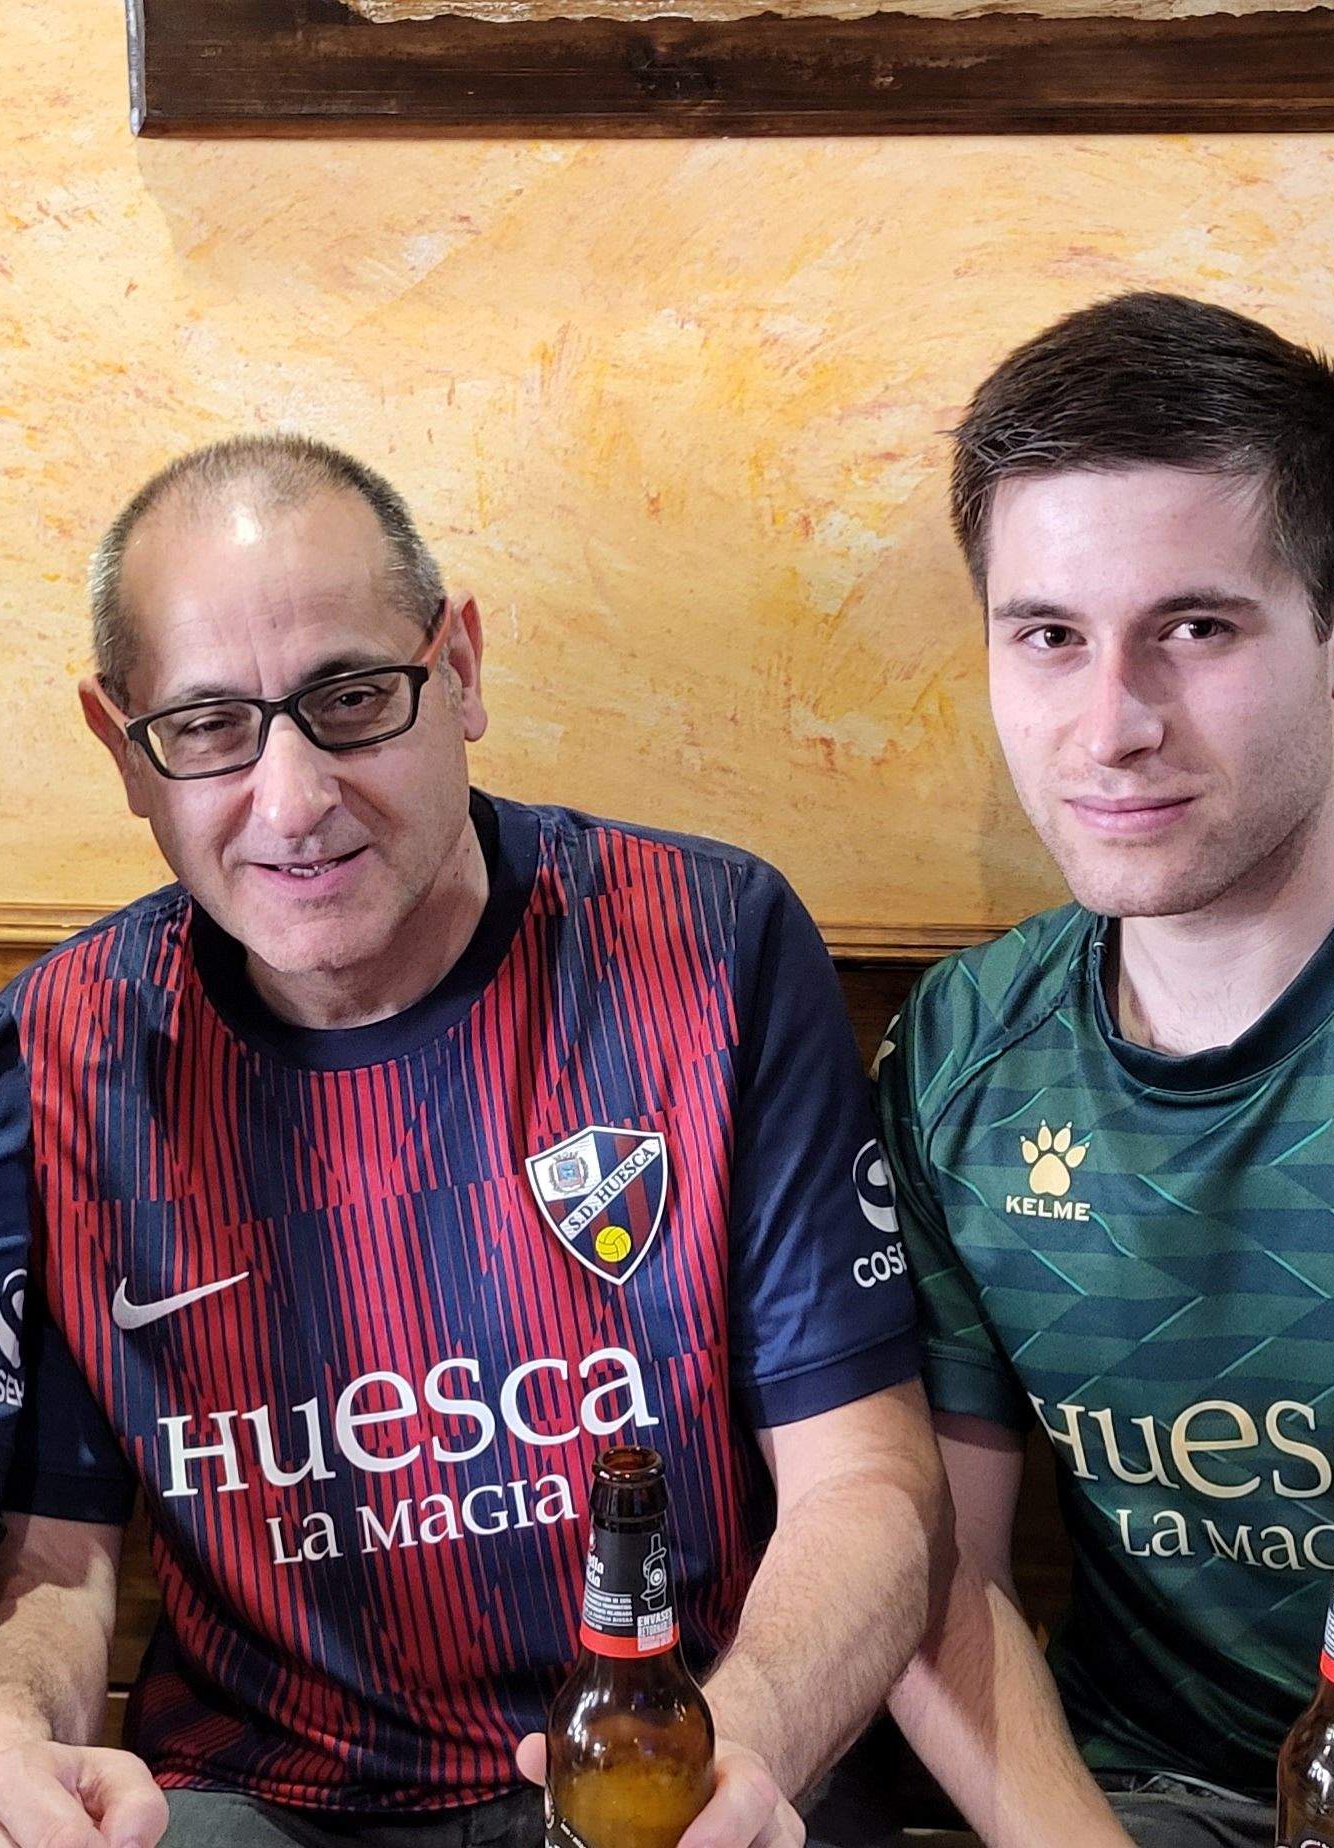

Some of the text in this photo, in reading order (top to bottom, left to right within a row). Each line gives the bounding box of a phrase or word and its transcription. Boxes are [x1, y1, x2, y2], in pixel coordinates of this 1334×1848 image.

[568, 1147, 655, 1231] S.D. HUESCA
[1006, 1195, 1090, 1221] KELME
[157, 1346, 660, 1498] Huesca
